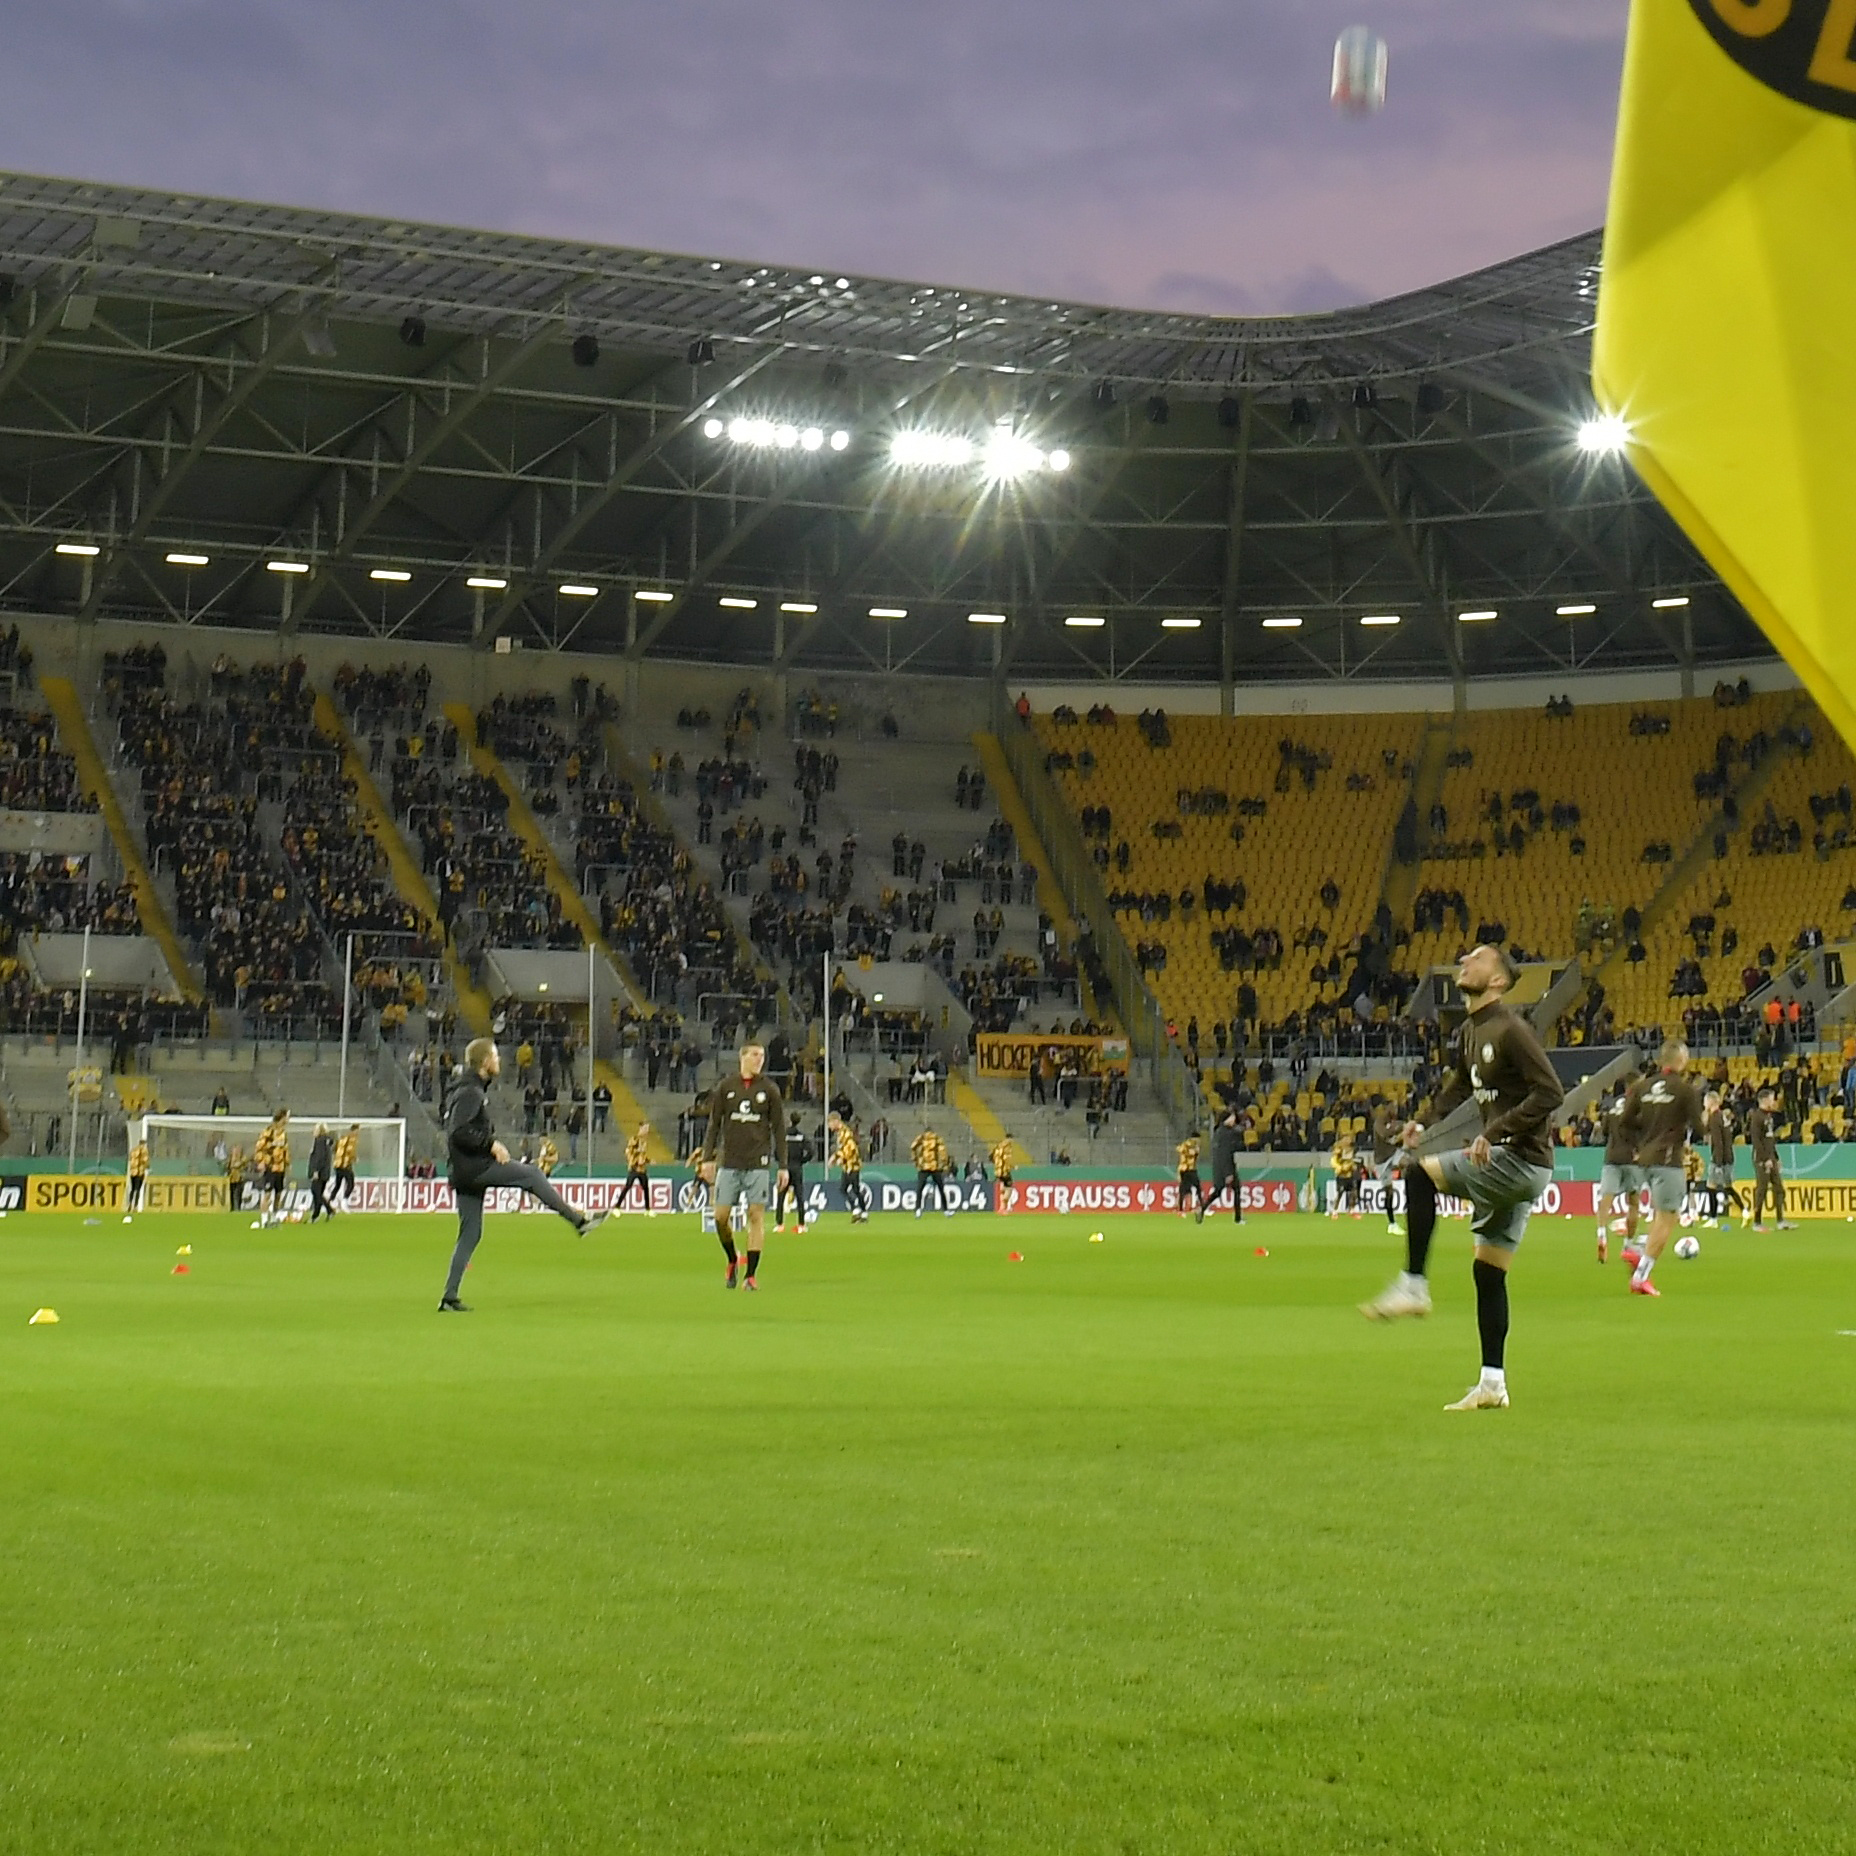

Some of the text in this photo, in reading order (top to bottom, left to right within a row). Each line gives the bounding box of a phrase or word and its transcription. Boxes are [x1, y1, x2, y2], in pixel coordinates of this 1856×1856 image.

[36, 1181, 228, 1208] SPORTETTEN
[348, 1183, 495, 1211] BAUHAS
[523, 1183, 669, 1210] UHAUS
[1026, 1185, 1131, 1209] STRAUSS
[1162, 1186, 1266, 1209] SUSS
